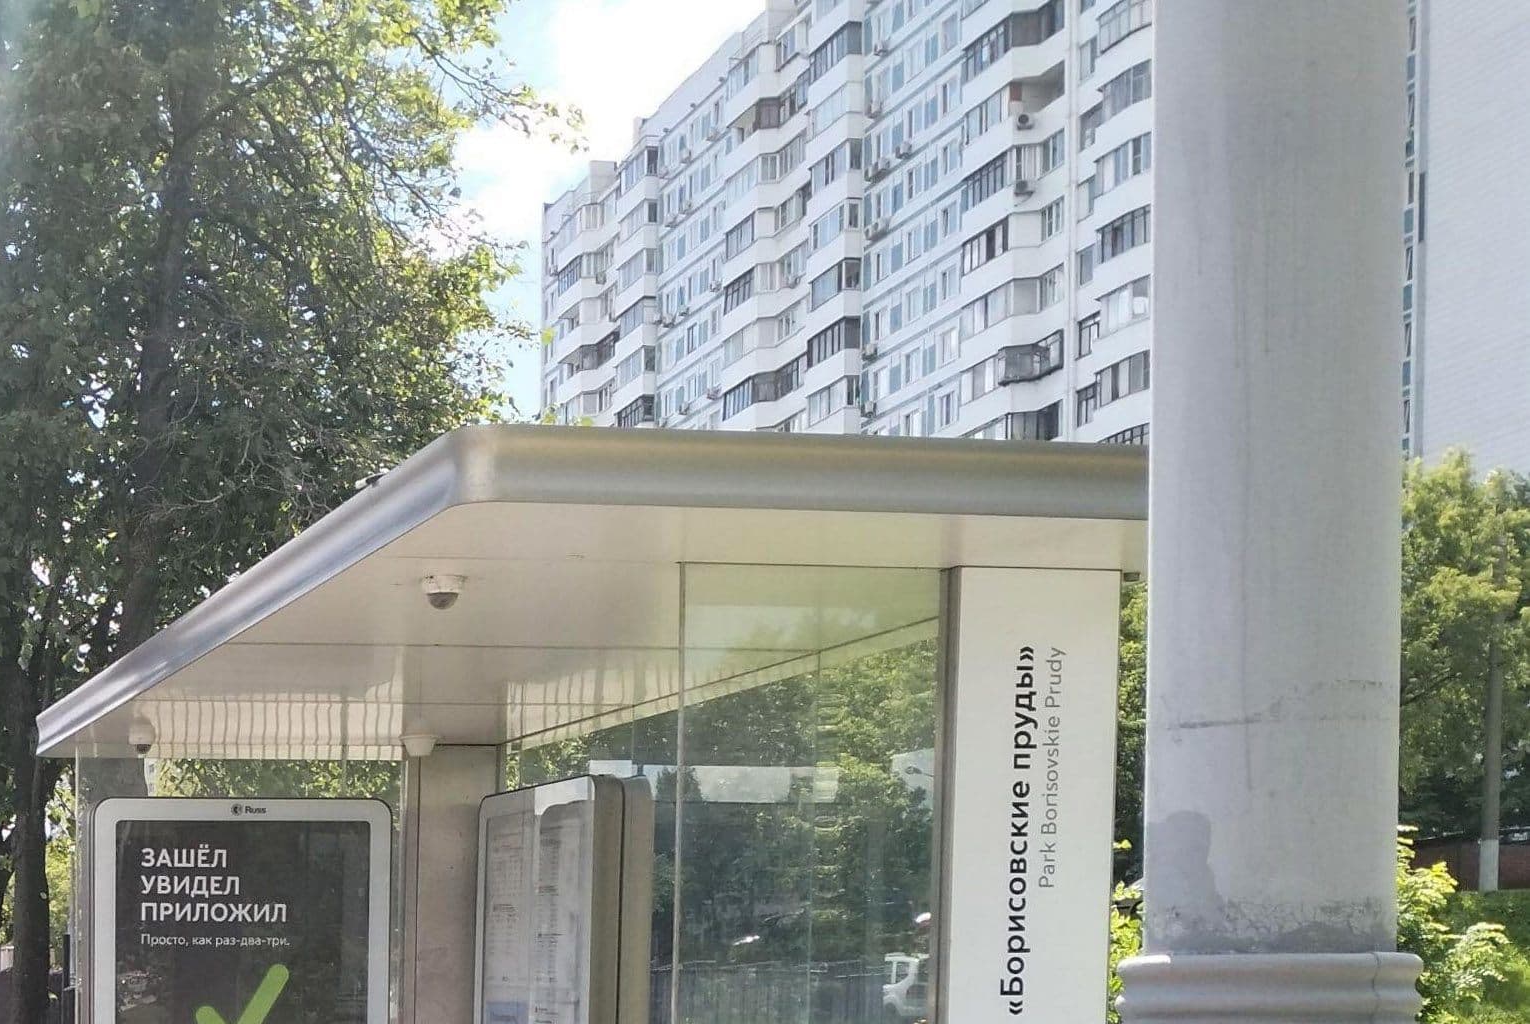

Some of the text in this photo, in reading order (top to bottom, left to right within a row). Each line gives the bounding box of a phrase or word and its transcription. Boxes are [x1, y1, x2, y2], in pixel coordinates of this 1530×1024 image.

[1013, 646, 1038, 770] пруды»
[1039, 647, 1066, 888] Park Borisovskie Prudy
[245, 805, 267, 815] Russ
[140, 843, 228, 869] ЗАШЁЛ
[140, 875, 241, 899] УВИДЕЛ
[1000, 781, 1031, 1016] «Борисовские
[140, 902, 288, 923] ПРИЛОЖИЛ
[140, 933, 290, 947] Просто, как раз-два-три.
